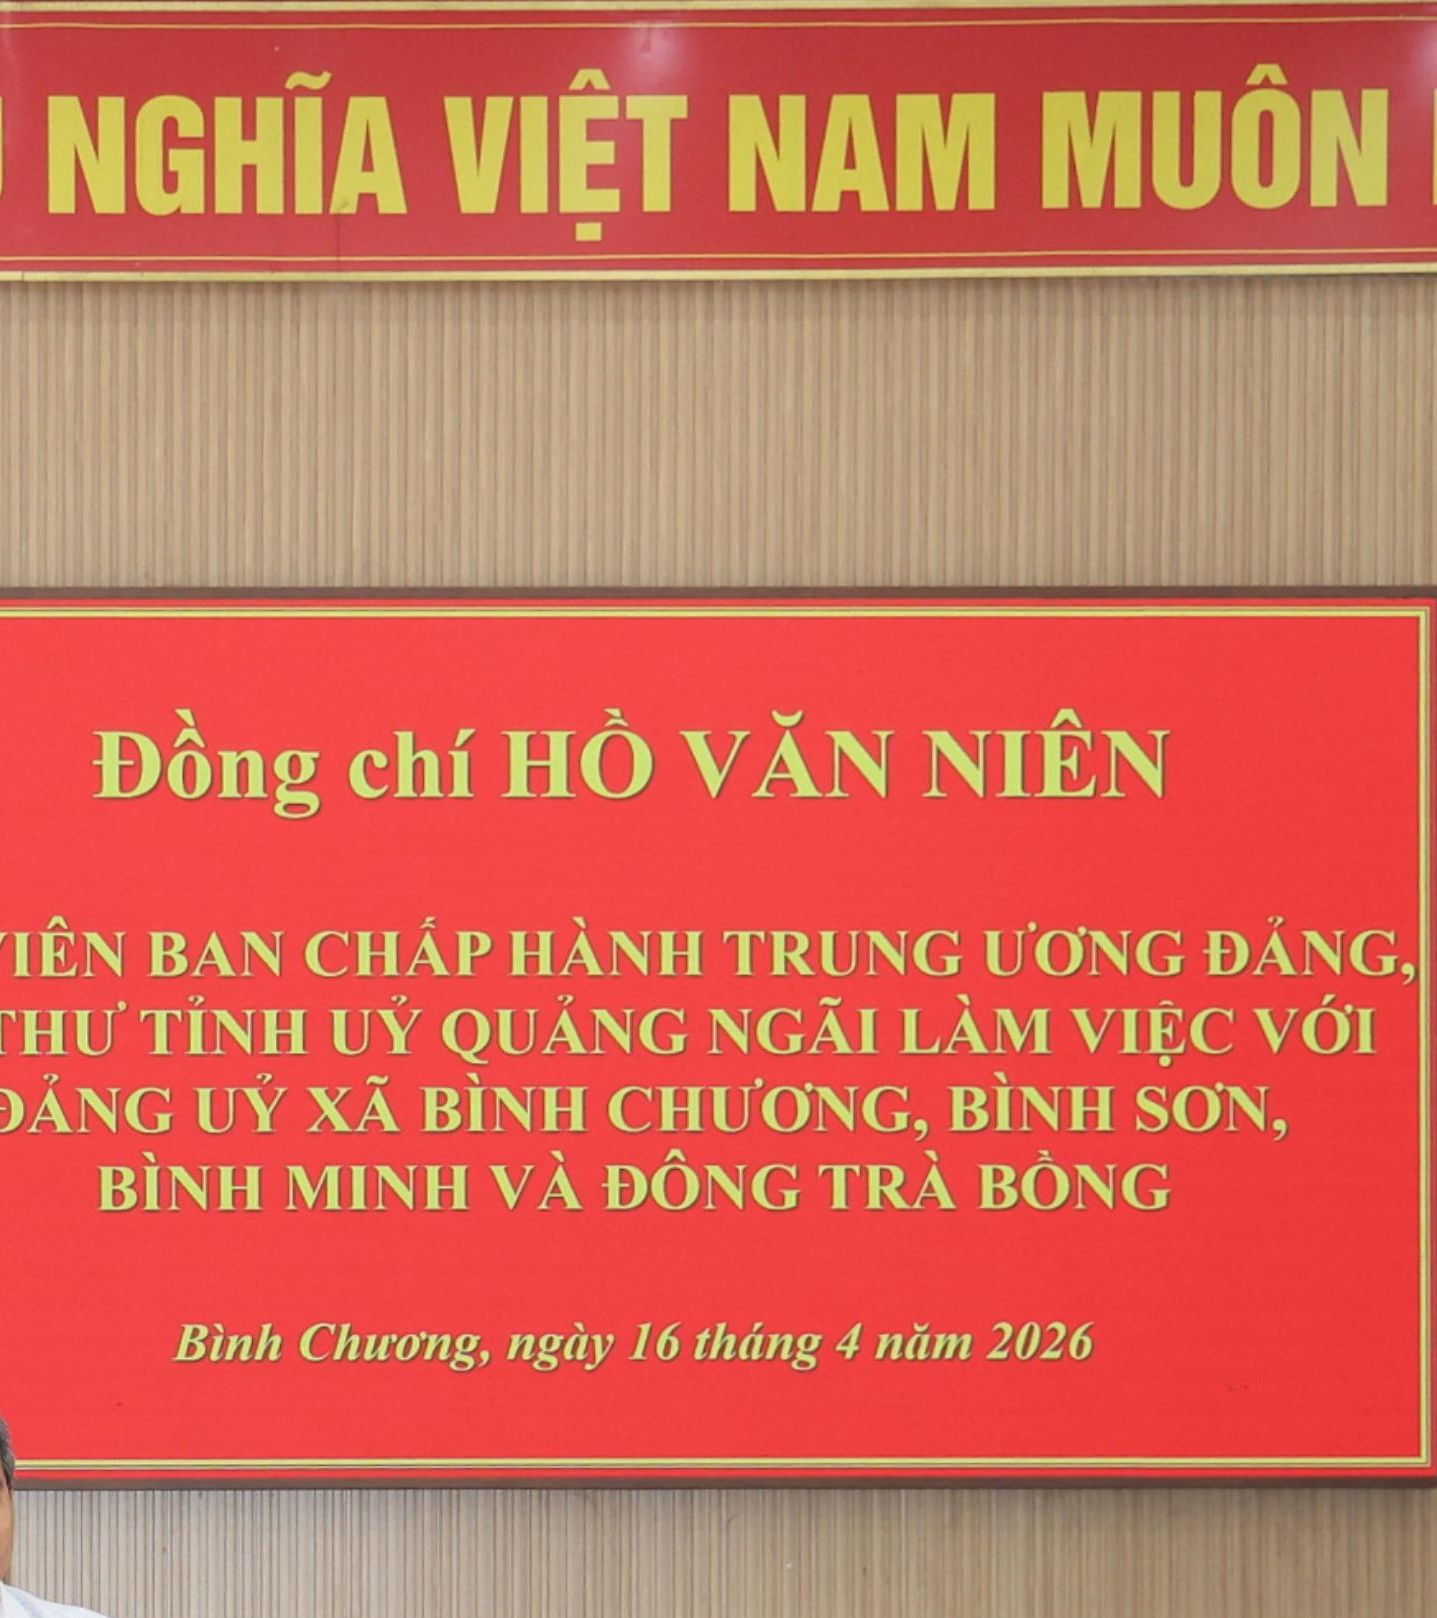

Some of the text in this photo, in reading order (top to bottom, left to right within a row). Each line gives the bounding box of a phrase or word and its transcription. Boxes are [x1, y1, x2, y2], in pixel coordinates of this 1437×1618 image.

[48, 72, 407, 216] NGHĨA
[444, 69, 688, 241] VIỆT
[729, 93, 996, 212] NAM
[1042, 64, 1389, 209] MUÔN
[93, 708, 1169, 819] Đồng chí HỒ VĂN NIÊN
[149, 931, 282, 976] BAN
[305, 917, 492, 977] CHẤP
[510, 916, 702, 976] HÀNH
[723, 930, 961, 976] TRUNG
[984, 922, 1184, 976] ƯƠNG
[1205, 916, 1415, 982] ĐẢNG,
[140, 996, 308, 1055] TỈNH
[442, 995, 685, 1064] QUẢNG
[709, 997, 877, 1054] NGÃI
[902, 994, 1051, 1054] LÀM
[1071, 1000, 1233, 1067] VIỆC
[1254, 994, 1374, 1054] VỚI
[309, 1075, 399, 1132] XÃ
[423, 1072, 586, 1131] BÌNH
[608, 1078, 928, 1139] CHƯƠNG,
[951, 1072, 1113, 1131] BÌNH
[1136, 1082, 1287, 1138] SƠN,
[99, 1148, 1169, 1210] BÌNH MINH VÀ ĐÔNG TRÀ BỒNG
[175, 1322, 1092, 1371] Bình Chương, ngày 16 tháng 4 năm 2026
